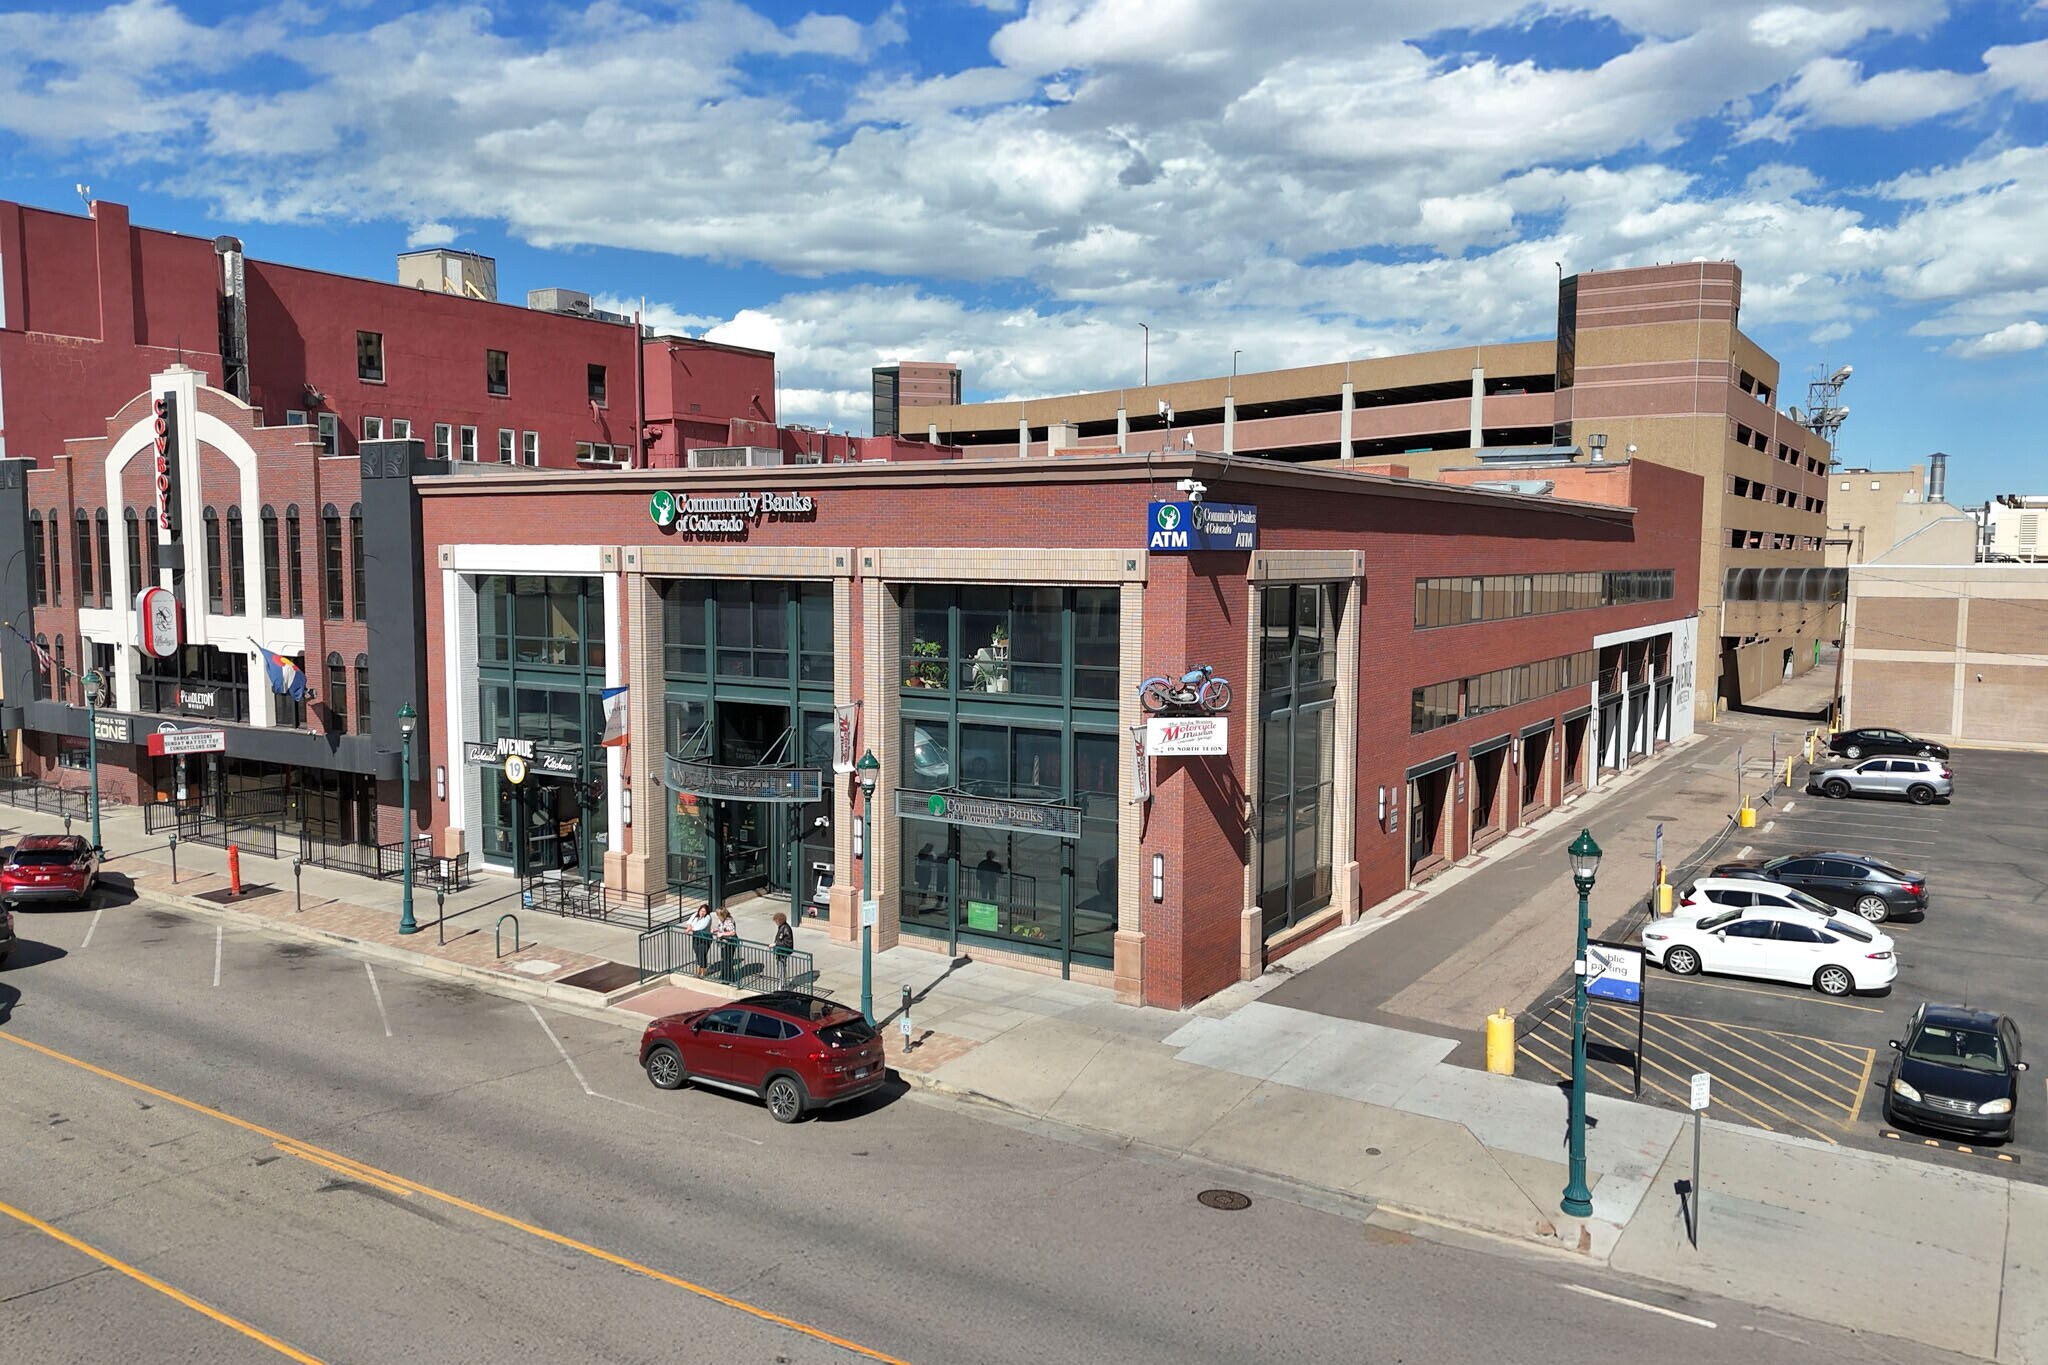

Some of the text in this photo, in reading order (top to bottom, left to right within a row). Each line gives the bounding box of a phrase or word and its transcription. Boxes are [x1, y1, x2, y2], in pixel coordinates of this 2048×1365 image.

[154, 398, 168, 530] COWBOYS
[675, 491, 813, 517] Community Banks
[675, 514, 744, 532] of Colorado
[1204, 507, 1257, 526] Community Banks
[1209, 523, 1232, 535] Colorado
[1150, 531, 1188, 547] ATM
[1235, 532, 1253, 548] ATM
[95, 724, 127, 740] ZONE
[1160, 723, 1217, 744] Motorcycle
[470, 747, 497, 761] Cocktails
[496, 737, 534, 759] AVENUE
[509, 762, 521, 777] 19
[946, 799, 1044, 823] Community Banks
[955, 812, 996, 826] Colorado
